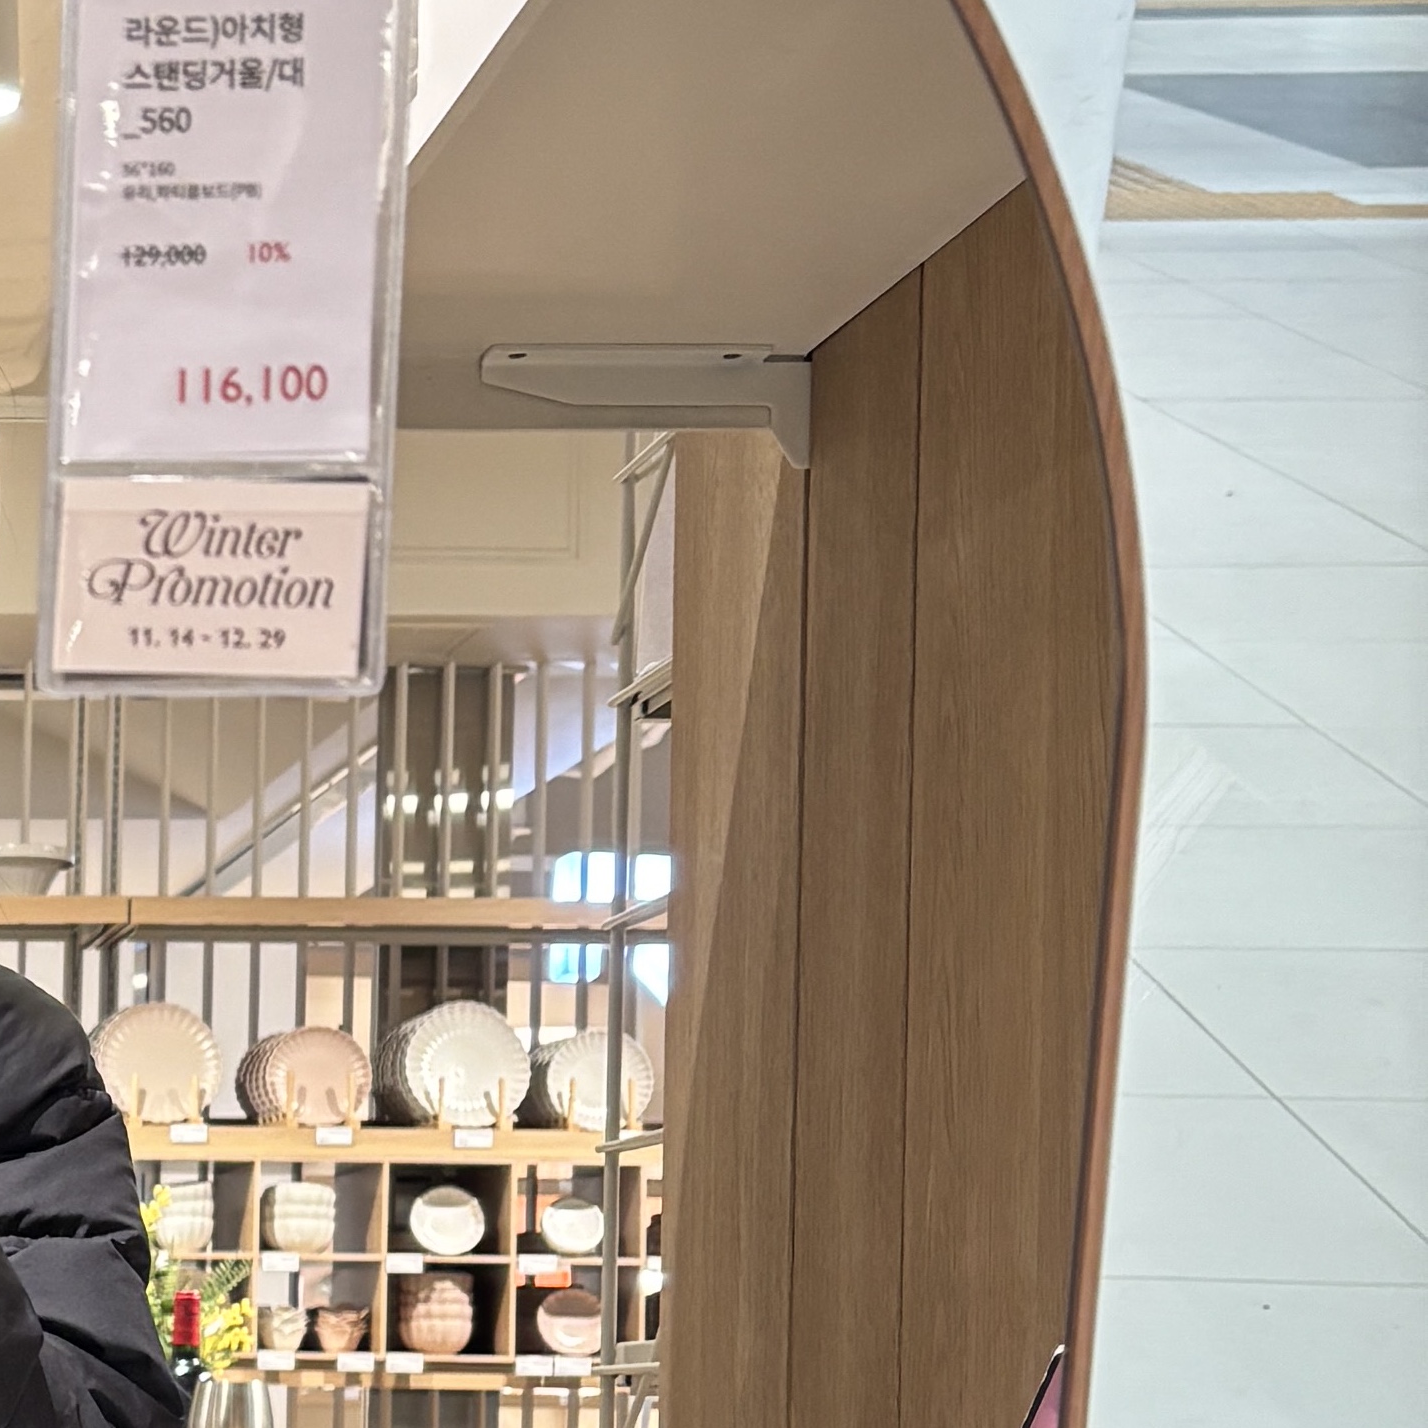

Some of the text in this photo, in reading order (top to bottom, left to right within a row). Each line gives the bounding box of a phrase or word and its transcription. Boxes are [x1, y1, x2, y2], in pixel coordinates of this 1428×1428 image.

[124, 12, 305, 47] 라운드)아치형
[122, 58, 305, 92] 스탠딩거울/대
[121, 106, 193, 140] _560
[120, 241, 292, 268] 129,000 10%
[175, 364, 329, 407] 116,100
[139, 508, 303, 559] Winter
[86, 556, 335, 609] Promotion
